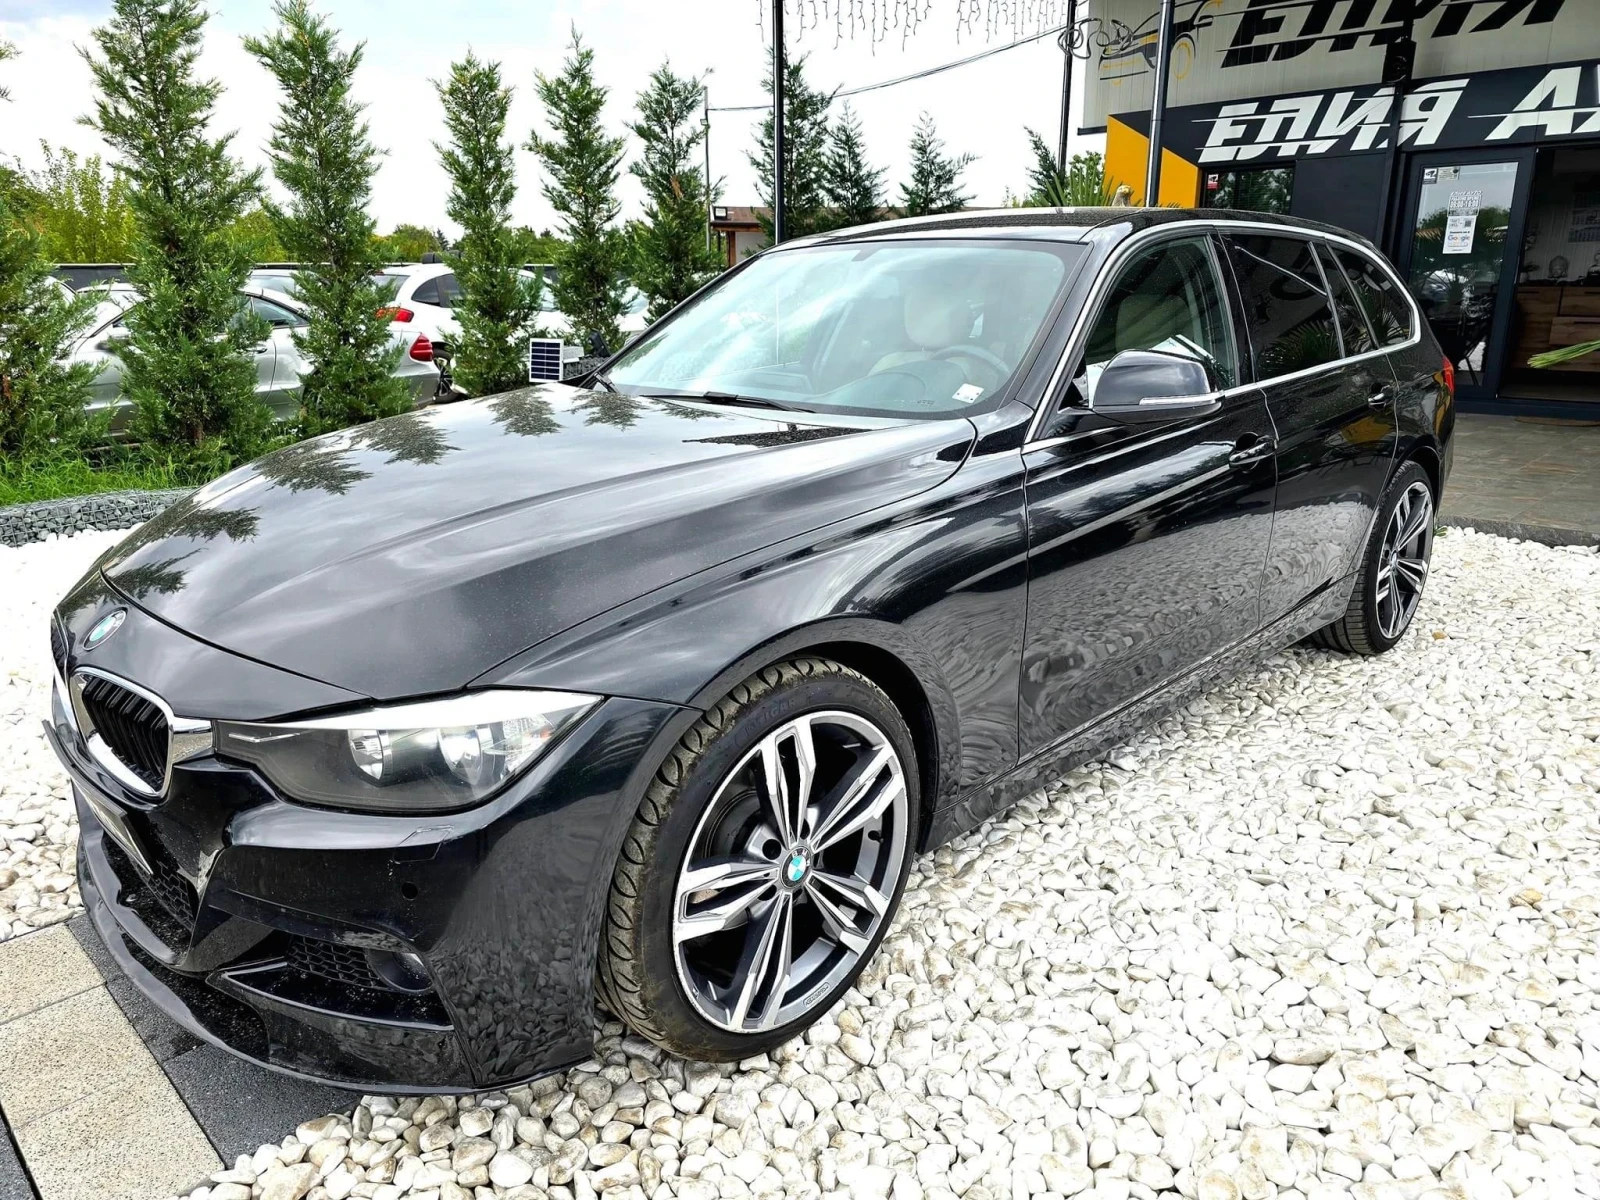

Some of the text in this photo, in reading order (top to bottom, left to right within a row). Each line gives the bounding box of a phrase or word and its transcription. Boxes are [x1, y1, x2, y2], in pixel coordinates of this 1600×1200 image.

[1196, 63, 1600, 163] ЕЛИЯ А
[791, 849, 811, 867] BMW
